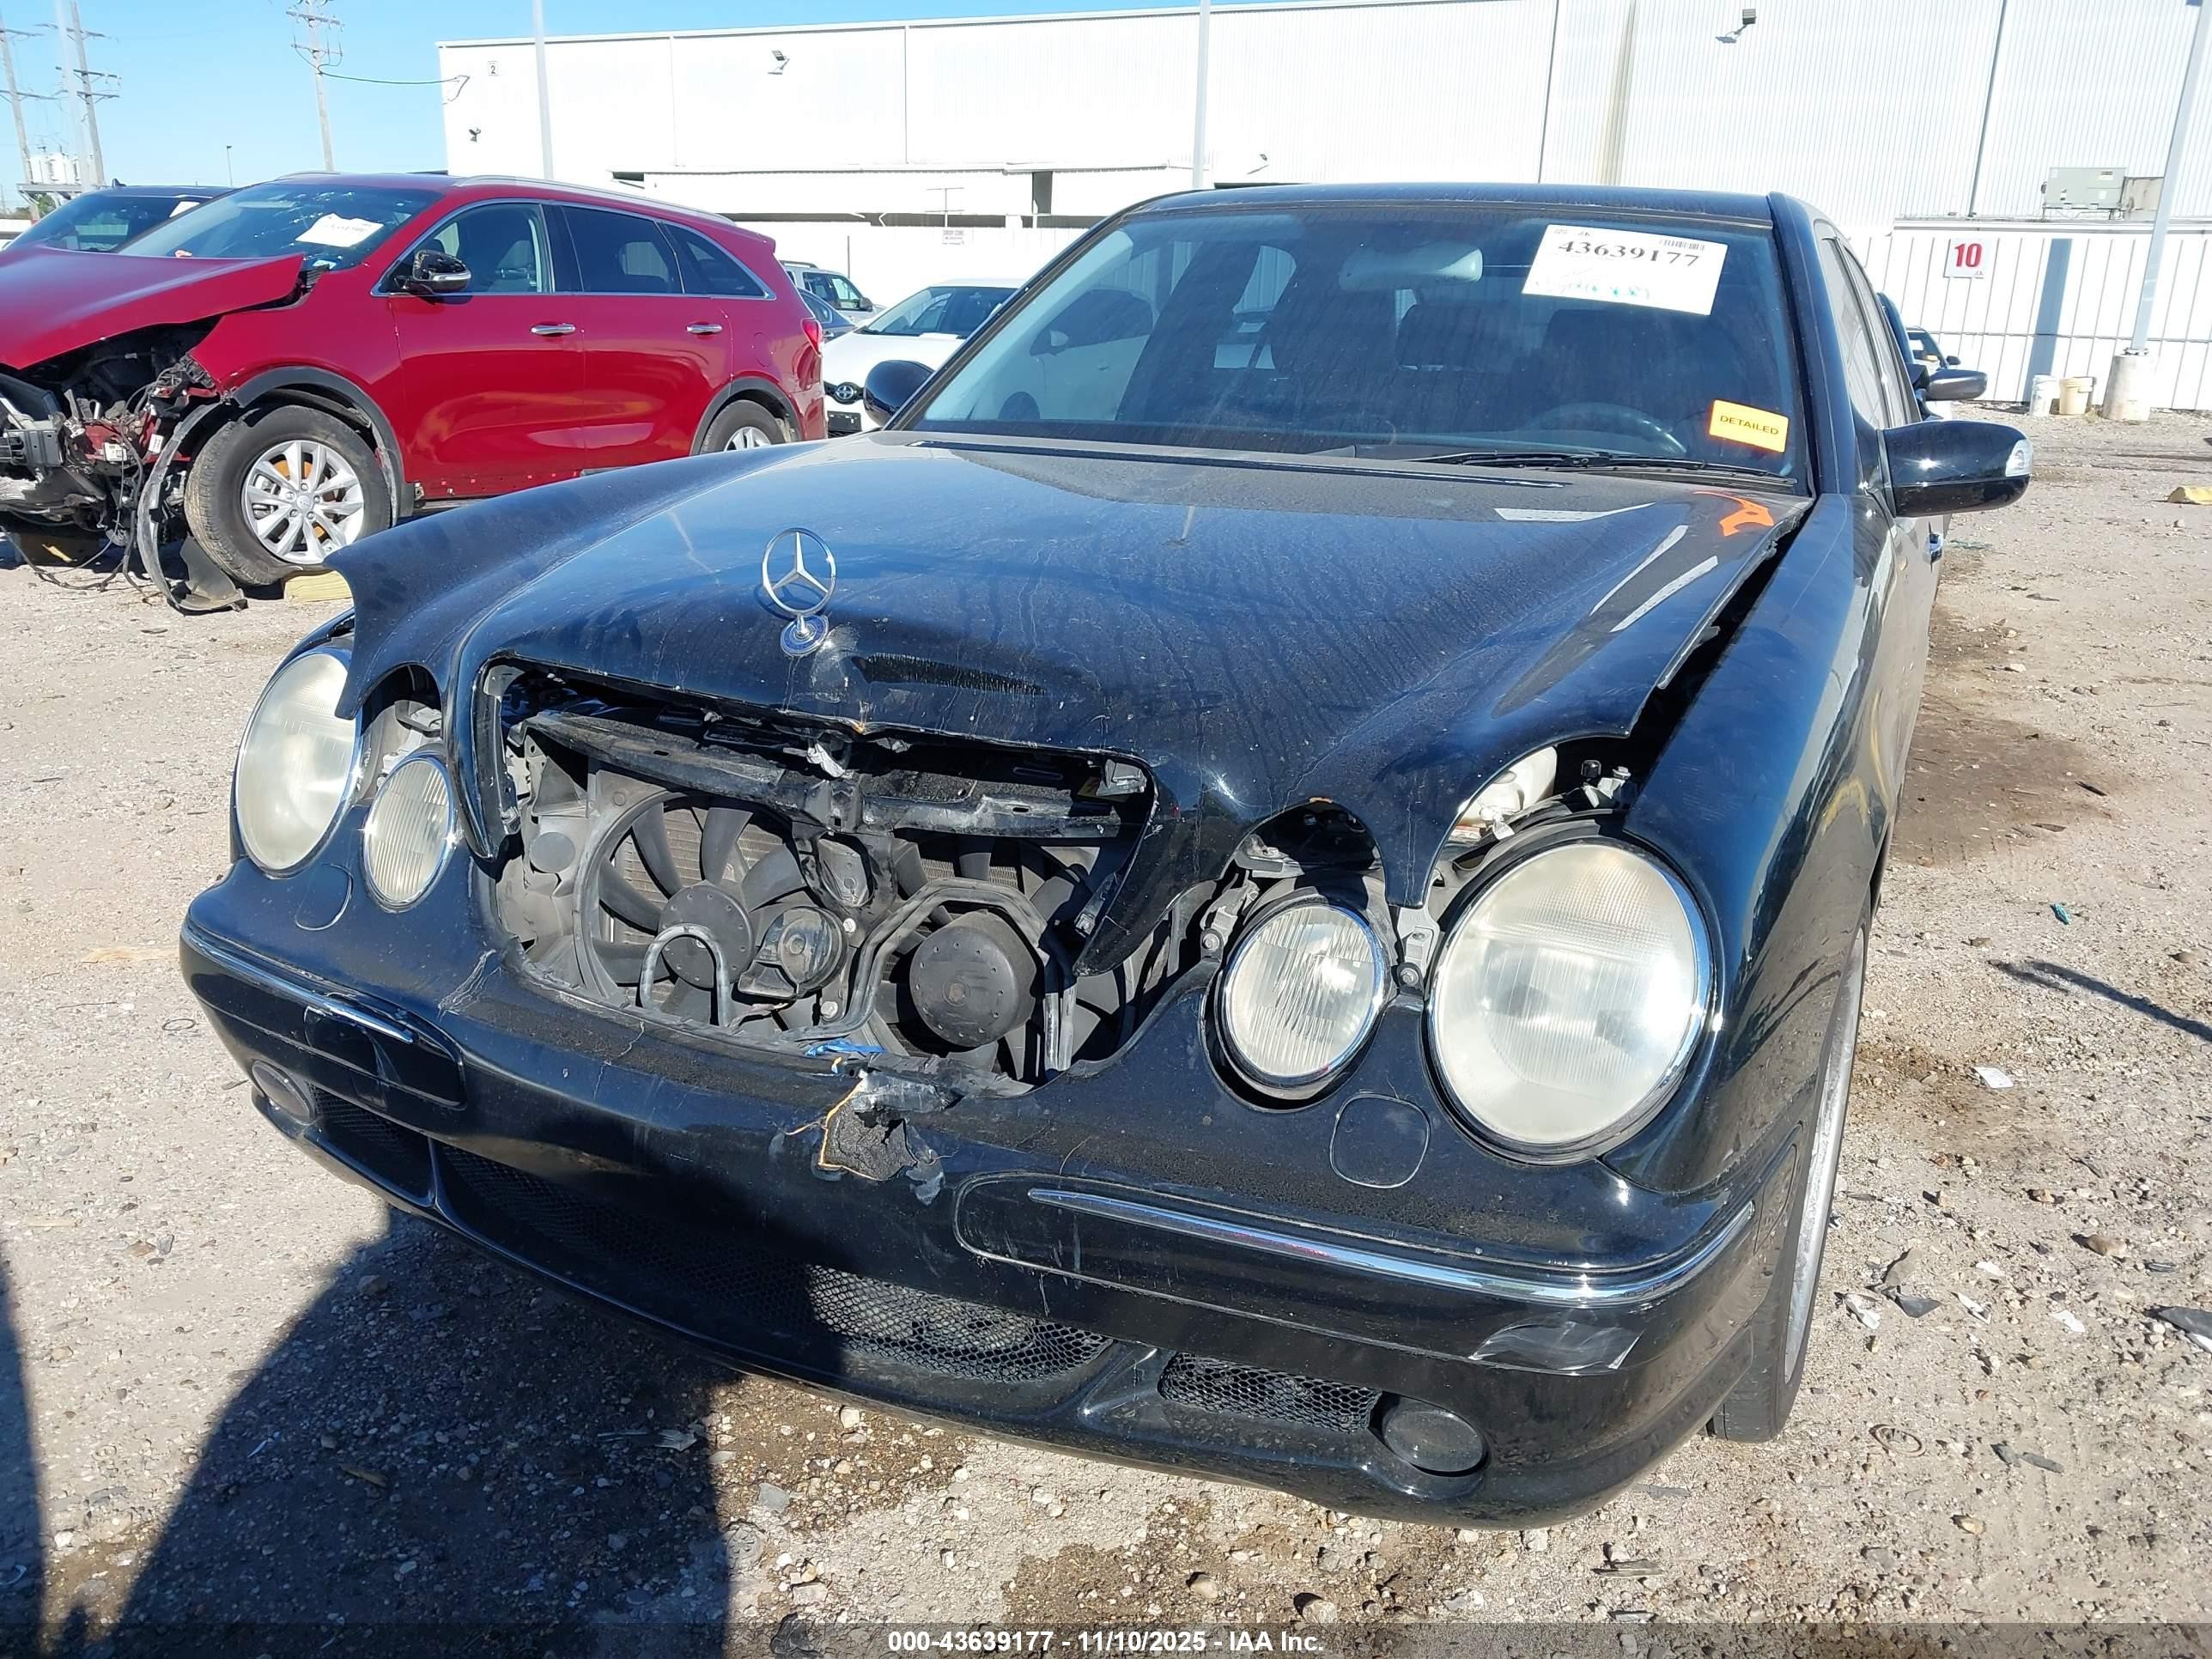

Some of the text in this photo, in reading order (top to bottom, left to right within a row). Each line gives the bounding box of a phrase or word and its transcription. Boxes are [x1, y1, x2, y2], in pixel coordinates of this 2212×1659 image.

[490, 65, 496, 74] 2
[1557, 240, 1699, 267] 43639177
[1954, 243, 1983, 268] 10
[1720, 415, 1778, 434] DETAILED
